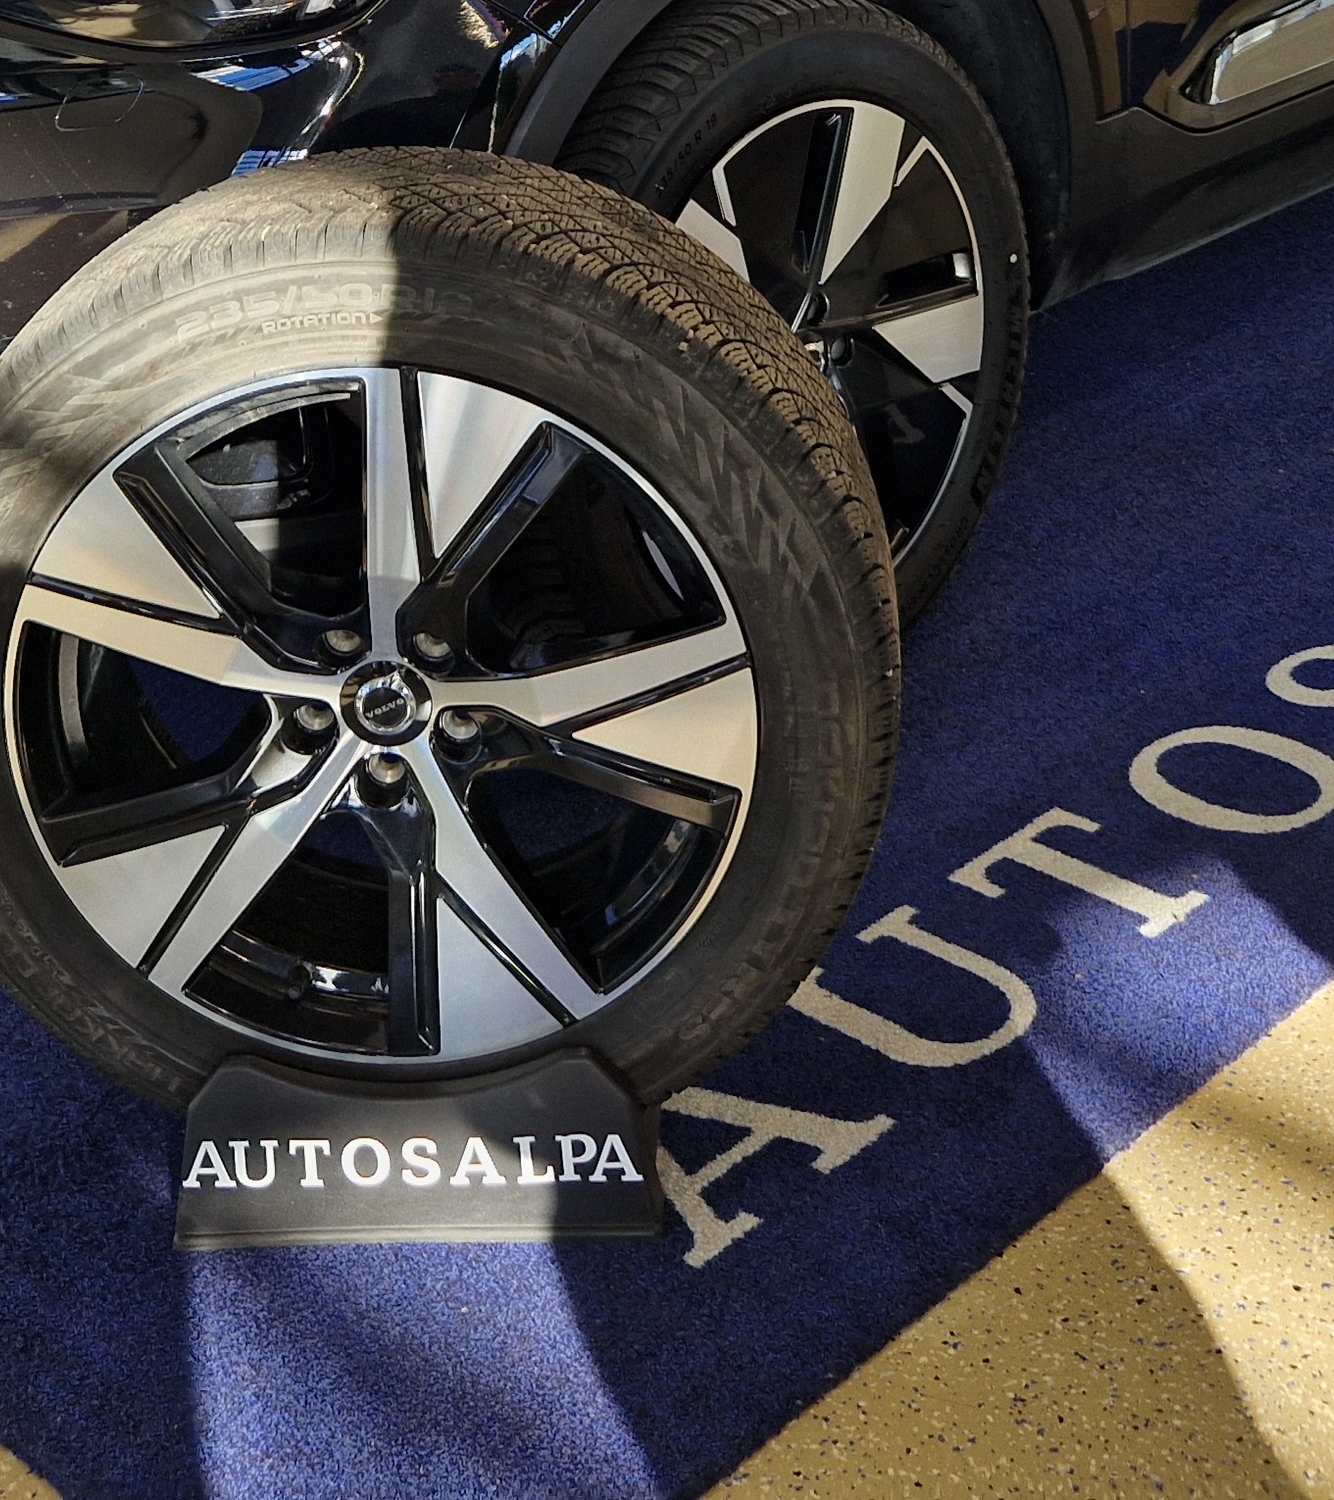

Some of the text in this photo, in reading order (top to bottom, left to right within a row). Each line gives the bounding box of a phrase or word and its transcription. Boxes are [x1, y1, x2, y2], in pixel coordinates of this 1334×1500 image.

[261, 310, 367, 335] ROTATION
[364, 697, 406, 719] VOLVO
[181, 1132, 645, 1190] AUTOSALPA
